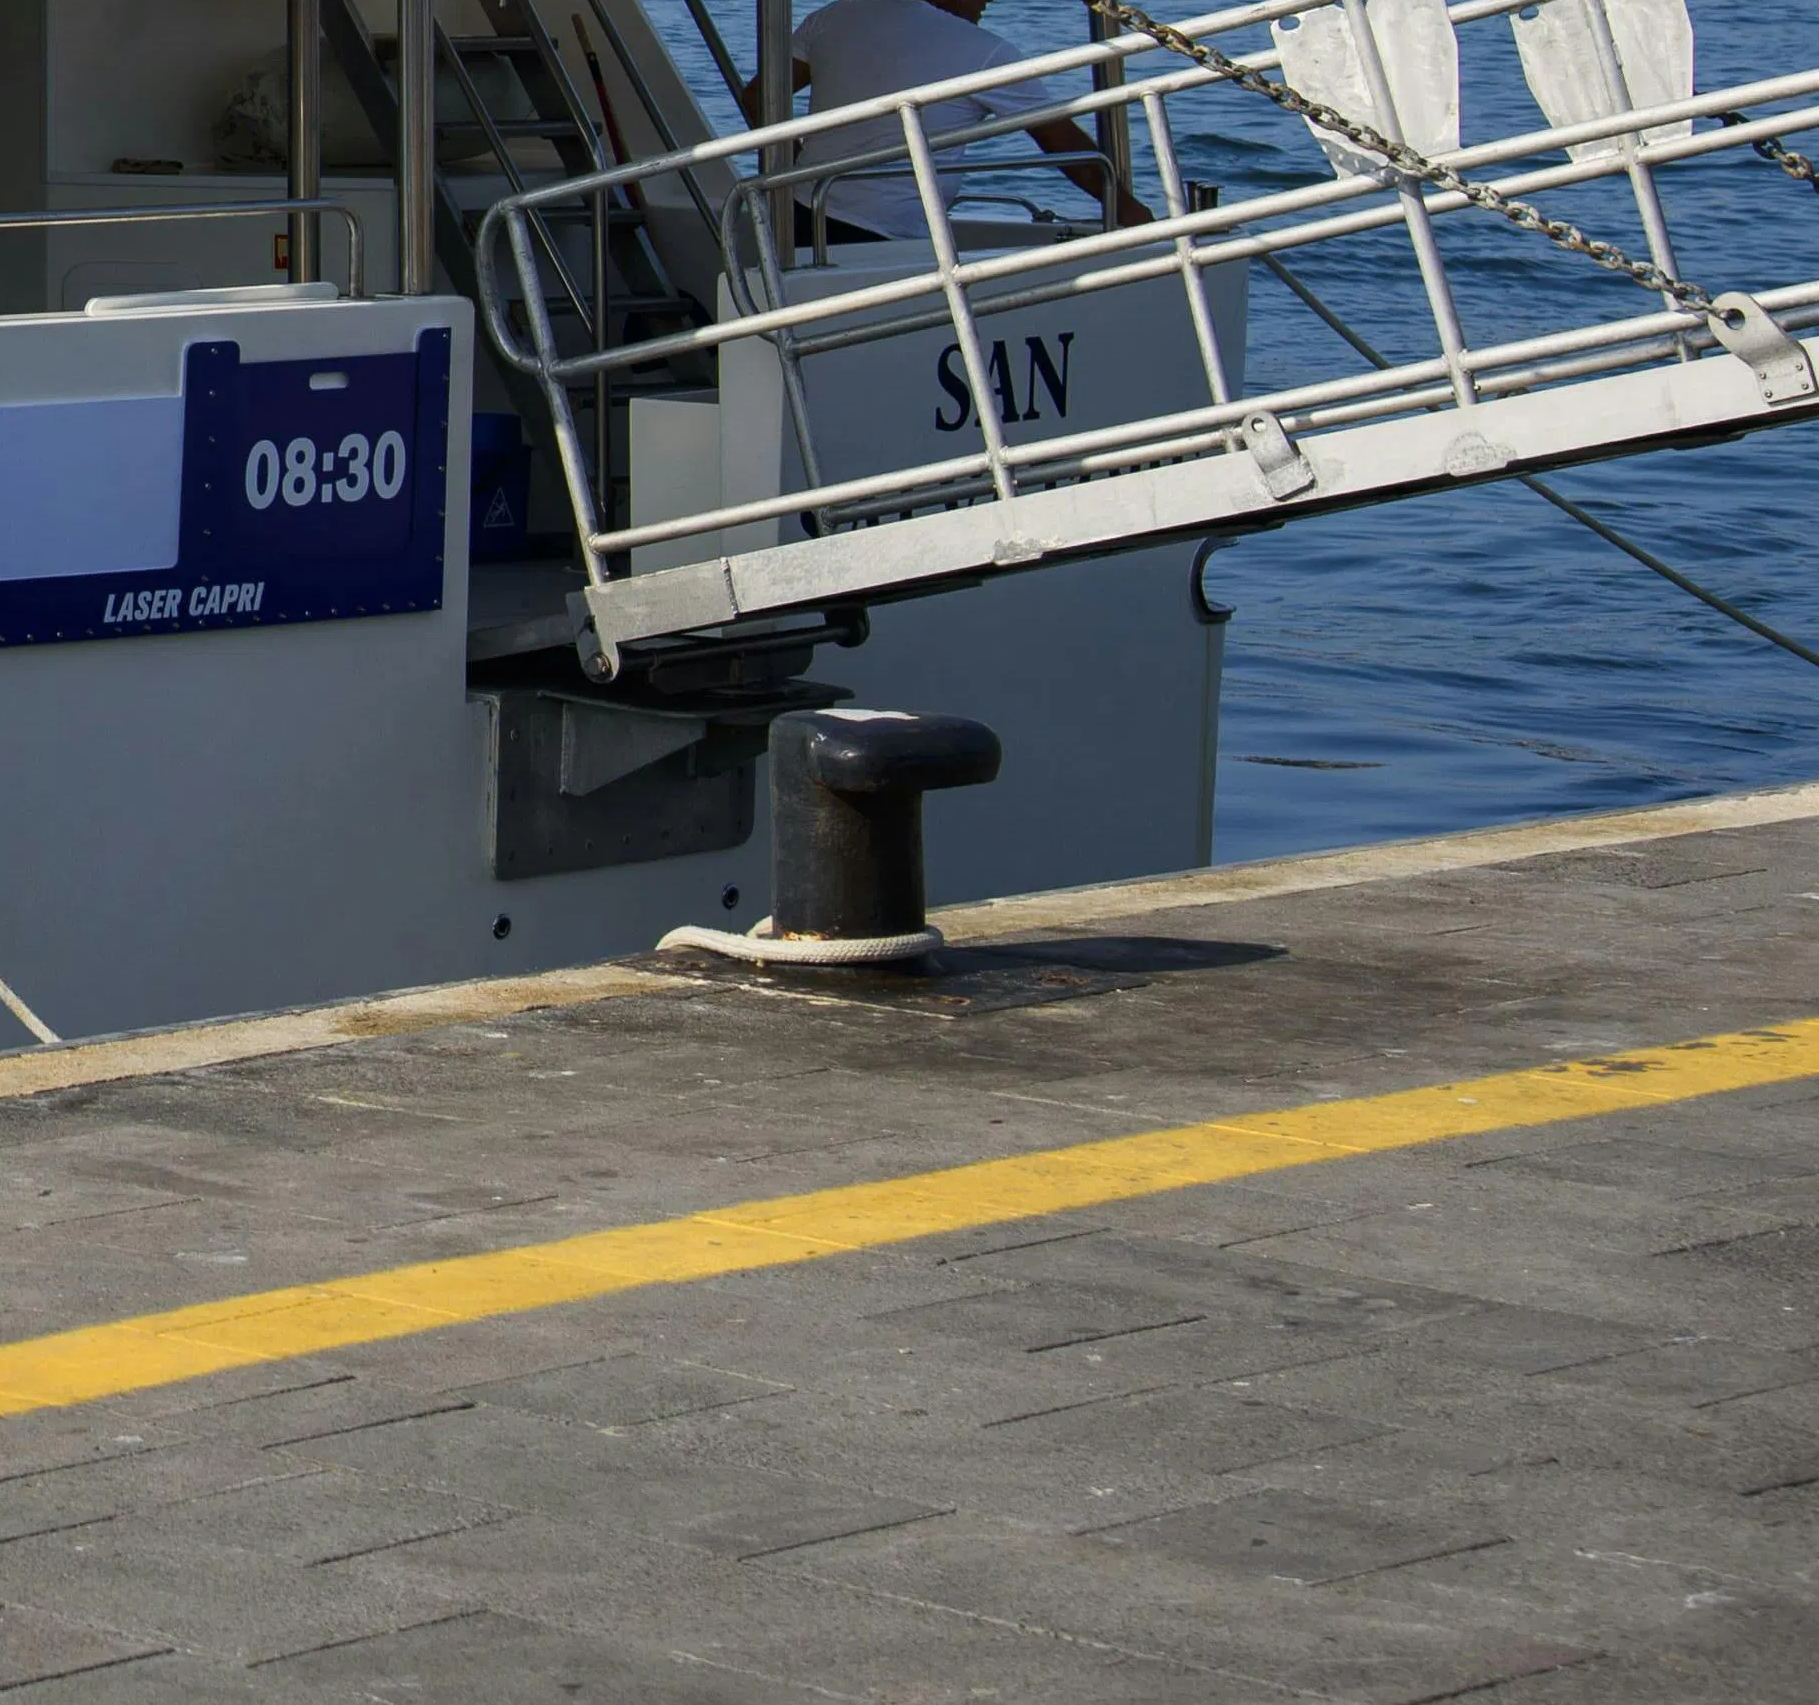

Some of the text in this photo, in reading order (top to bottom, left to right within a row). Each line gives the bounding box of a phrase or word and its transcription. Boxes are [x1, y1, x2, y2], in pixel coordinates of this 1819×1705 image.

[935, 332, 1075, 432] SAN
[245, 429, 407, 510] 08:30
[103, 581, 265, 623] LASER CAPRI
